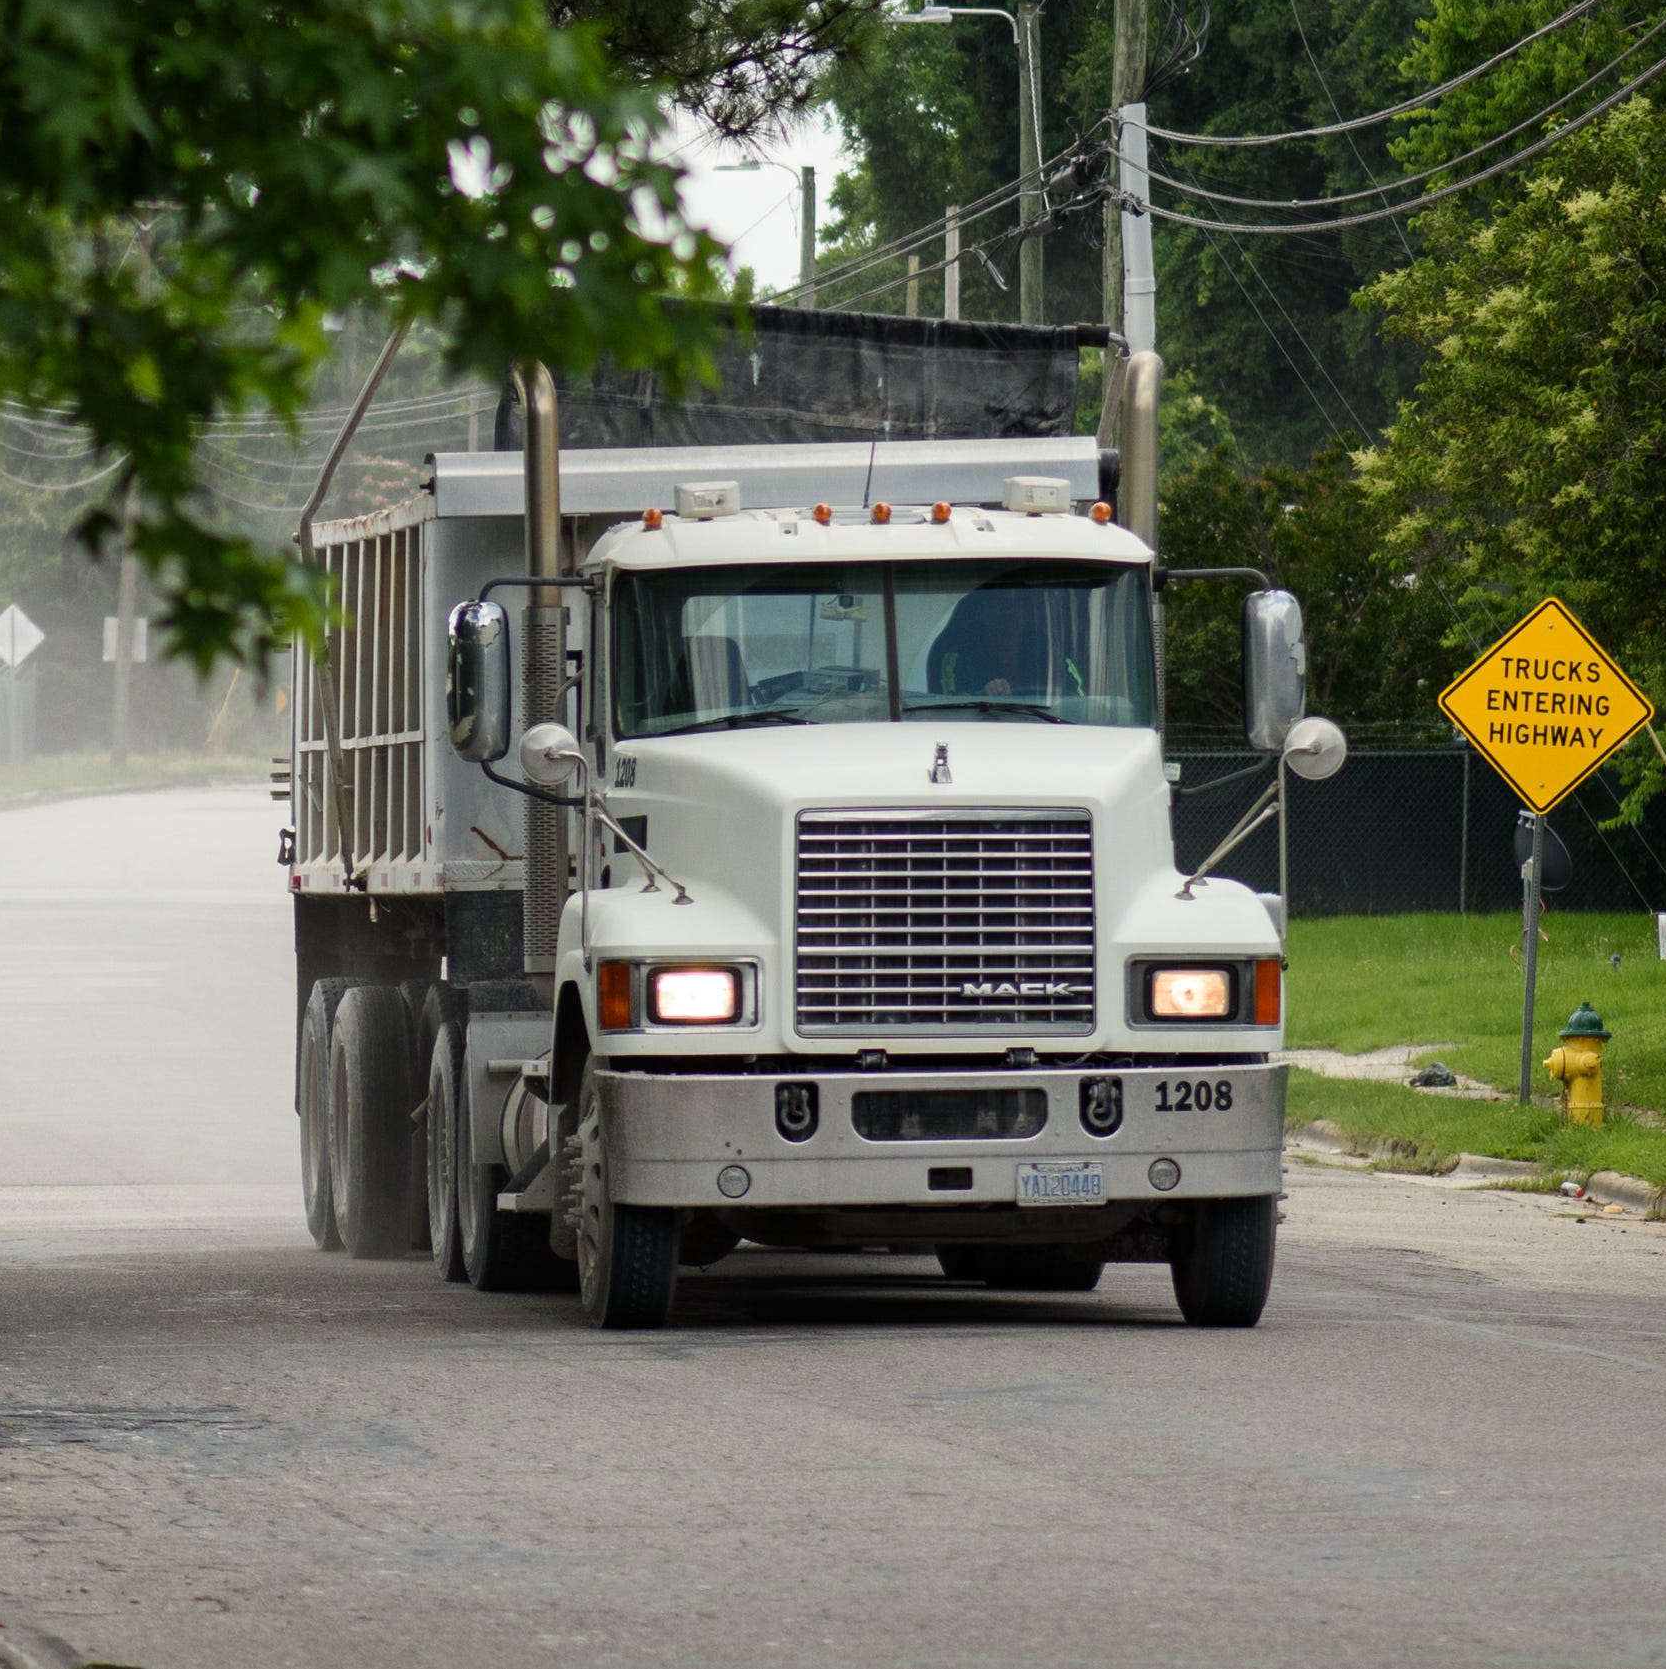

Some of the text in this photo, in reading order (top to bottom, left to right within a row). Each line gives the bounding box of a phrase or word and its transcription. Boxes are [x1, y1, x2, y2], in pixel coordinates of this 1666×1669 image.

[1501, 657, 1601, 683] TRUCKS
[1486, 689, 1610, 717] ENTERING
[1489, 721, 1604, 748] HIGHWAY
[614, 757, 637, 788] 1208
[962, 982, 1075, 997] MACK
[1154, 1080, 1233, 1112] 1208
